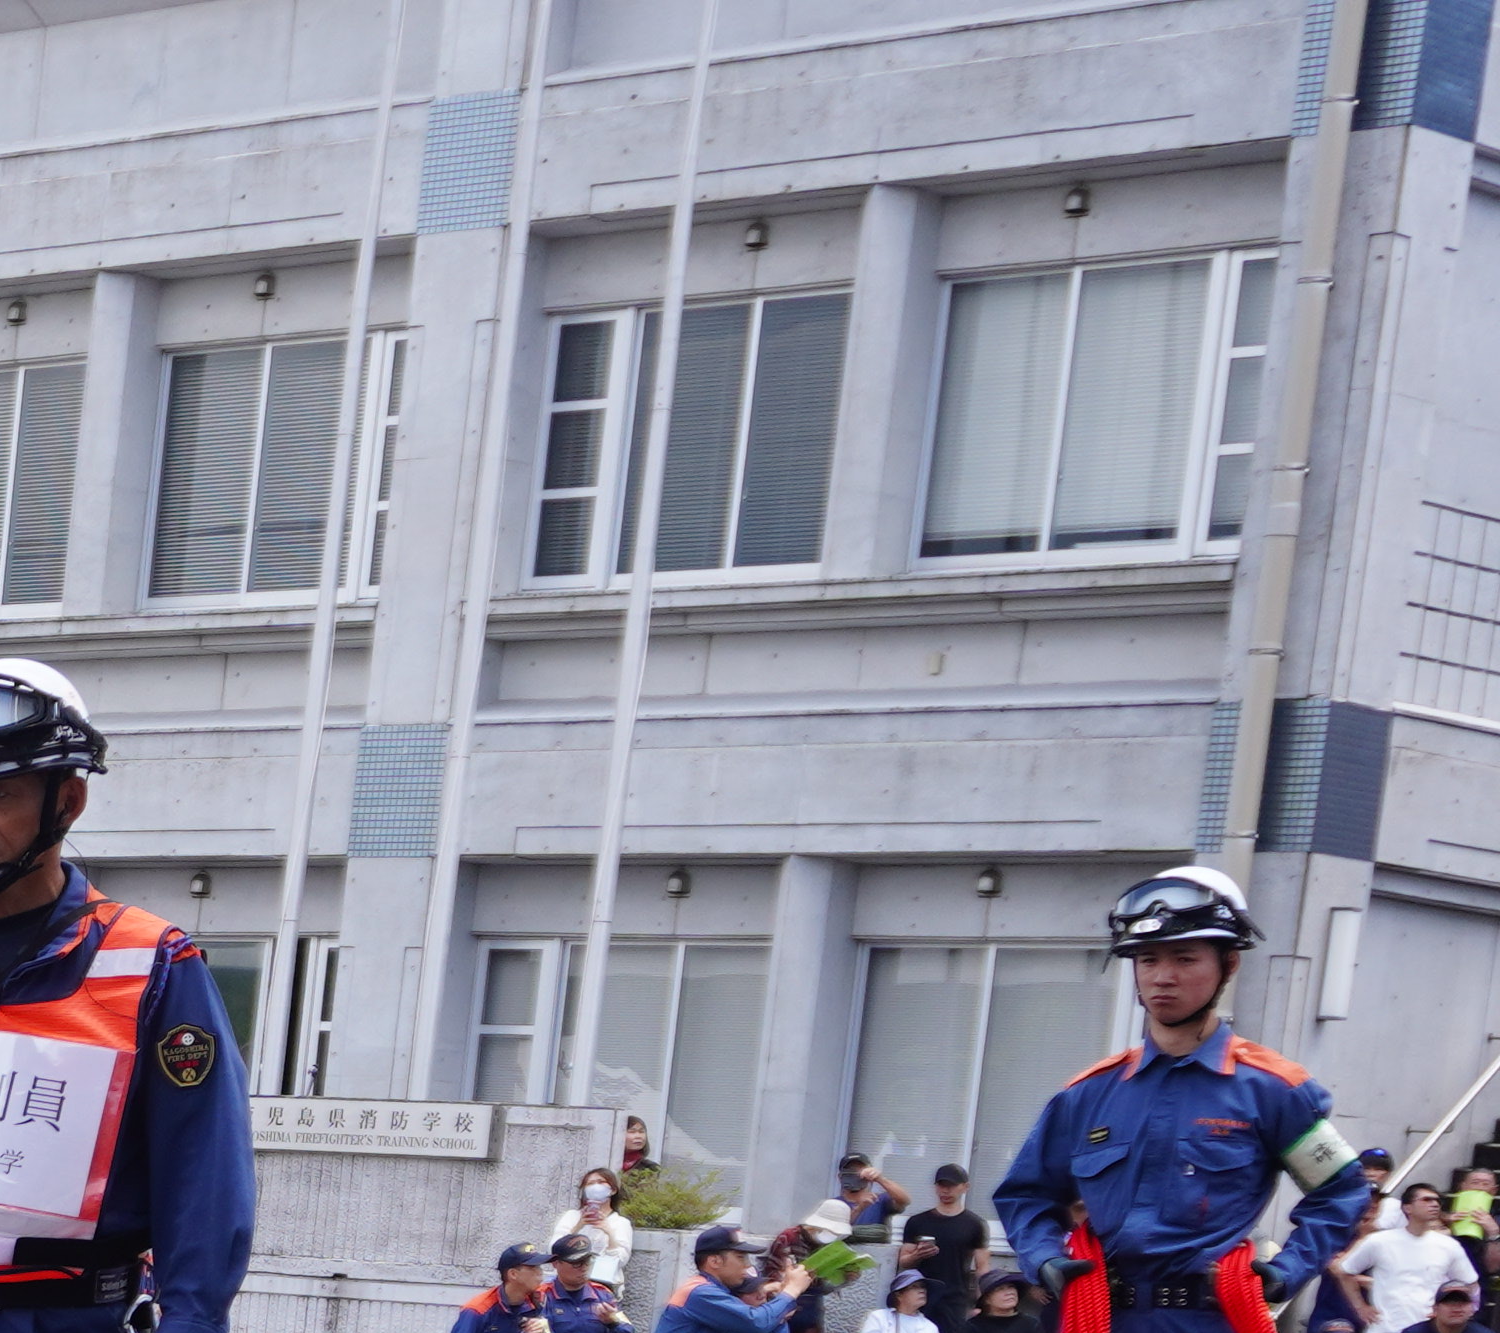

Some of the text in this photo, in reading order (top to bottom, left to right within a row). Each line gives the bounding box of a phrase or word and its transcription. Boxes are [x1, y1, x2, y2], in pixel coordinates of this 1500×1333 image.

[250, 1105, 476, 1134] 児島県消防学校
[295, 1131, 374, 1147] FIREFIGHTER'S
[376, 1135, 429, 1149] TRAINING
[432, 1137, 477, 1152] SCHOOL
